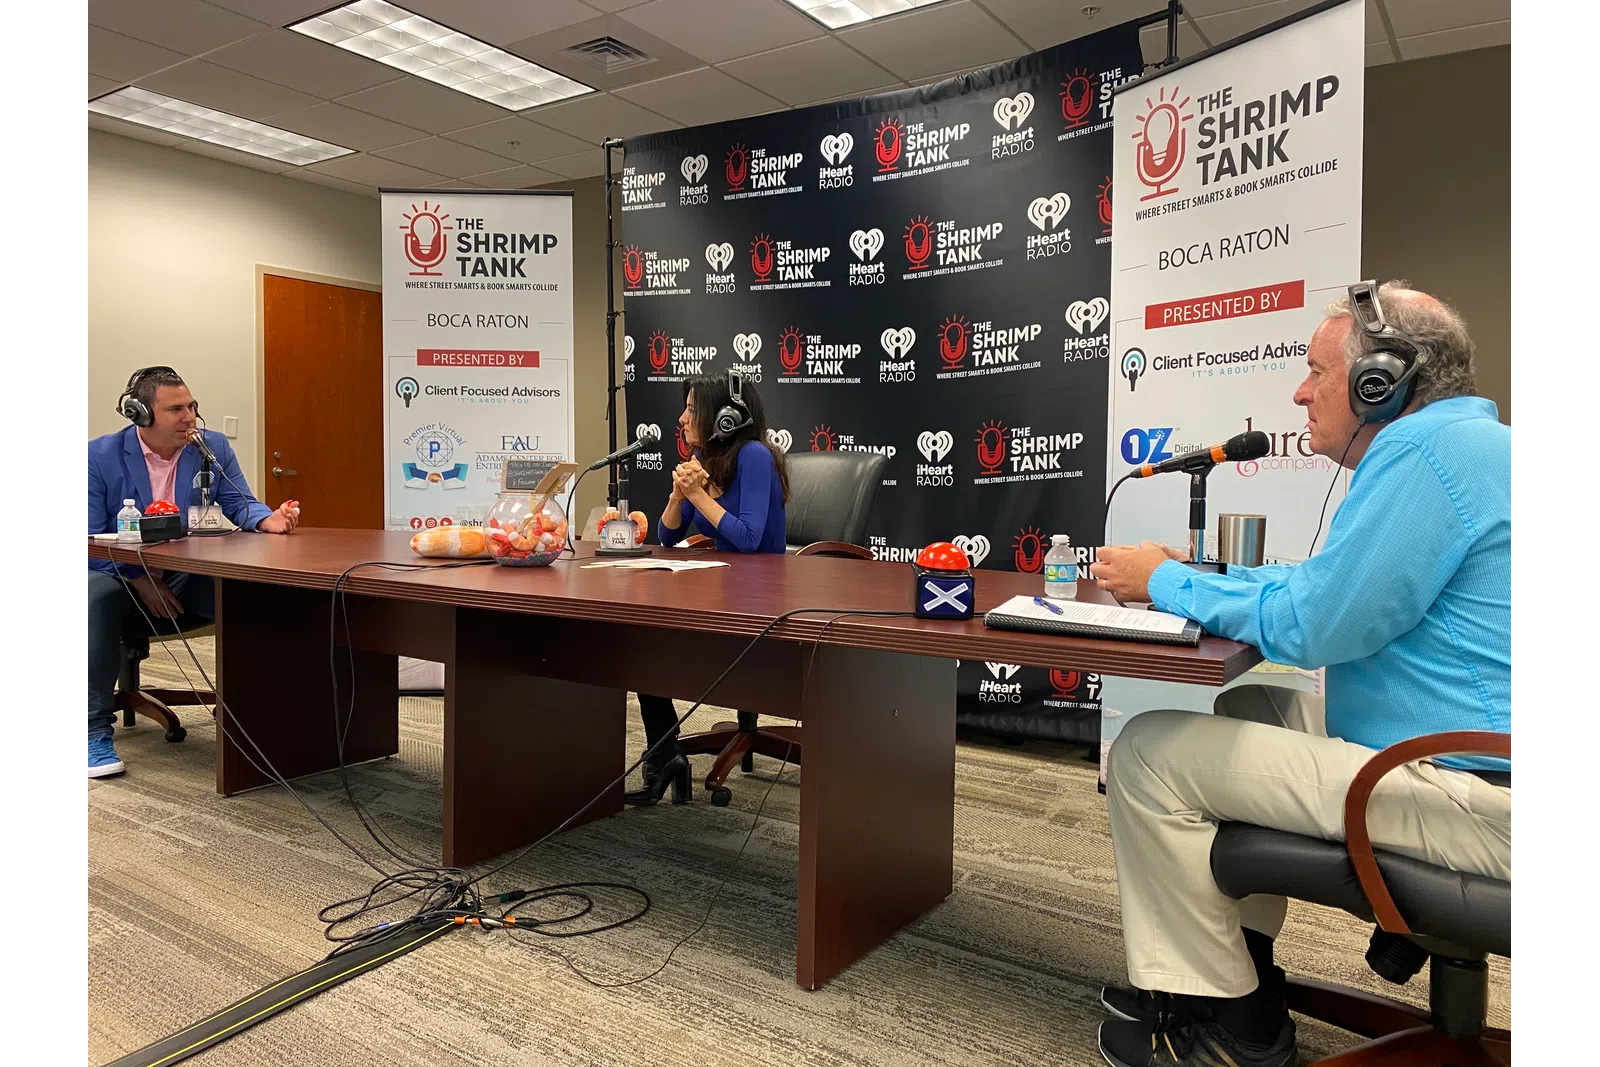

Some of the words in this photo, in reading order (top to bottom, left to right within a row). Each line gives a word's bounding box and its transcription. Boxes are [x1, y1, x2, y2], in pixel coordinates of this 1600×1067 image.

[1100, 68, 1122, 82] THE
[1197, 86, 1233, 114] THE
[1197, 75, 1340, 149] SHRIMP
[906, 123, 924, 134] THE
[906, 123, 970, 150] SHRIMP
[992, 127, 1034, 147] iHeart
[751, 149, 766, 158] THE
[905, 144, 949, 167] TANK
[991, 139, 1035, 160] RADIO
[751, 153, 803, 173] SHRIMP
[1196, 128, 1291, 186] TANK
[624, 167, 635, 176] THE
[819, 164, 853, 179] iHeart
[622, 172, 666, 189] SHRIMP
[750, 171, 786, 188] TANK
[819, 175, 854, 189] RADIO
[622, 188, 652, 203] TANK
[680, 184, 708, 196] iHeart
[1135, 206, 1161, 221] WHERE
[1162, 198, 1191, 214] STREET
[1192, 190, 1224, 207] SMARTS
[1226, 188, 1232, 198] &
[1235, 180, 1258, 196] BOOK
[1259, 169, 1295, 190] SMARTS
[1297, 159, 1338, 179] COLLIDE
[680, 194, 708, 206] RADIO
[456, 218, 483, 230] THE
[937, 220, 955, 231] THE
[937, 222, 1003, 248] SHRIMP
[1027, 228, 1071, 249] iHeart
[457, 233, 558, 254] SHRIMP
[777, 241, 791, 250] THE
[1158, 242, 1213, 271] BOCA
[1220, 224, 1289, 259] RATON
[645, 252, 657, 260] THE
[777, 247, 831, 265] SHRIMP
[937, 244, 982, 265] TANK
[1026, 241, 1072, 261] RADIO
[456, 257, 527, 277] TANK
[645, 258, 690, 274] SHRIMP
[777, 264, 814, 280] TANK
[849, 261, 885, 275] iHeart
[646, 274, 677, 288] TANK
[706, 273, 735, 284] iHeart
[849, 273, 886, 286] RADIO
[706, 283, 736, 293] RADIO
[1163, 295, 1255, 324] PRESENTED
[1261, 290, 1282, 310] BY
[427, 314, 471, 327] BOCA
[477, 315, 528, 328] RATON
[973, 321, 992, 332] THE
[671, 338, 684, 346] THE
[806, 336, 821, 344] THE
[972, 324, 1042, 349] SHRIMP
[1064, 333, 1109, 351] iHeart
[671, 347, 717, 360] SHRIMP
[806, 344, 861, 359] SHRIMP
[972, 345, 1019, 367] TANK
[1064, 346, 1109, 363] RADIO
[1153, 354, 1193, 371] Client
[1199, 346, 1259, 367] Focused
[1262, 342, 1311, 360] Advis
[433, 353, 504, 365] PRESENTED
[509, 355, 524, 365] BY
[880, 359, 916, 372] iHeart
[671, 361, 703, 374] TANK
[806, 361, 844, 375] TANK
[1193, 369, 1213, 378] IT'S
[1219, 365, 1256, 375] ABOUT
[1263, 362, 1286, 372] YOU
[879, 371, 916, 383] RADIO
[425, 385, 458, 396] Client
[461, 386, 508, 396] Focused
[511, 387, 560, 397] Advisors
[404, 424, 435, 445] Premier
[439, 422, 466, 446] Virtual
[1011, 427, 1030, 437] THE
[501, 436, 540, 452] FAU
[838, 435, 854, 444] THE
[1011, 433, 1084, 454] SHRIMP
[636, 461, 662, 470] RADIO
[916, 463, 953, 476] iHeart
[1010, 453, 1061, 472] TANK
[1262, 458, 1332, 472] company
[916, 475, 954, 487] RADIO
[870, 536, 886, 545] THE
[870, 546, 923, 562] SHRIM
[980, 680, 1022, 693] iHeart
[979, 692, 1022, 703] RADIO
